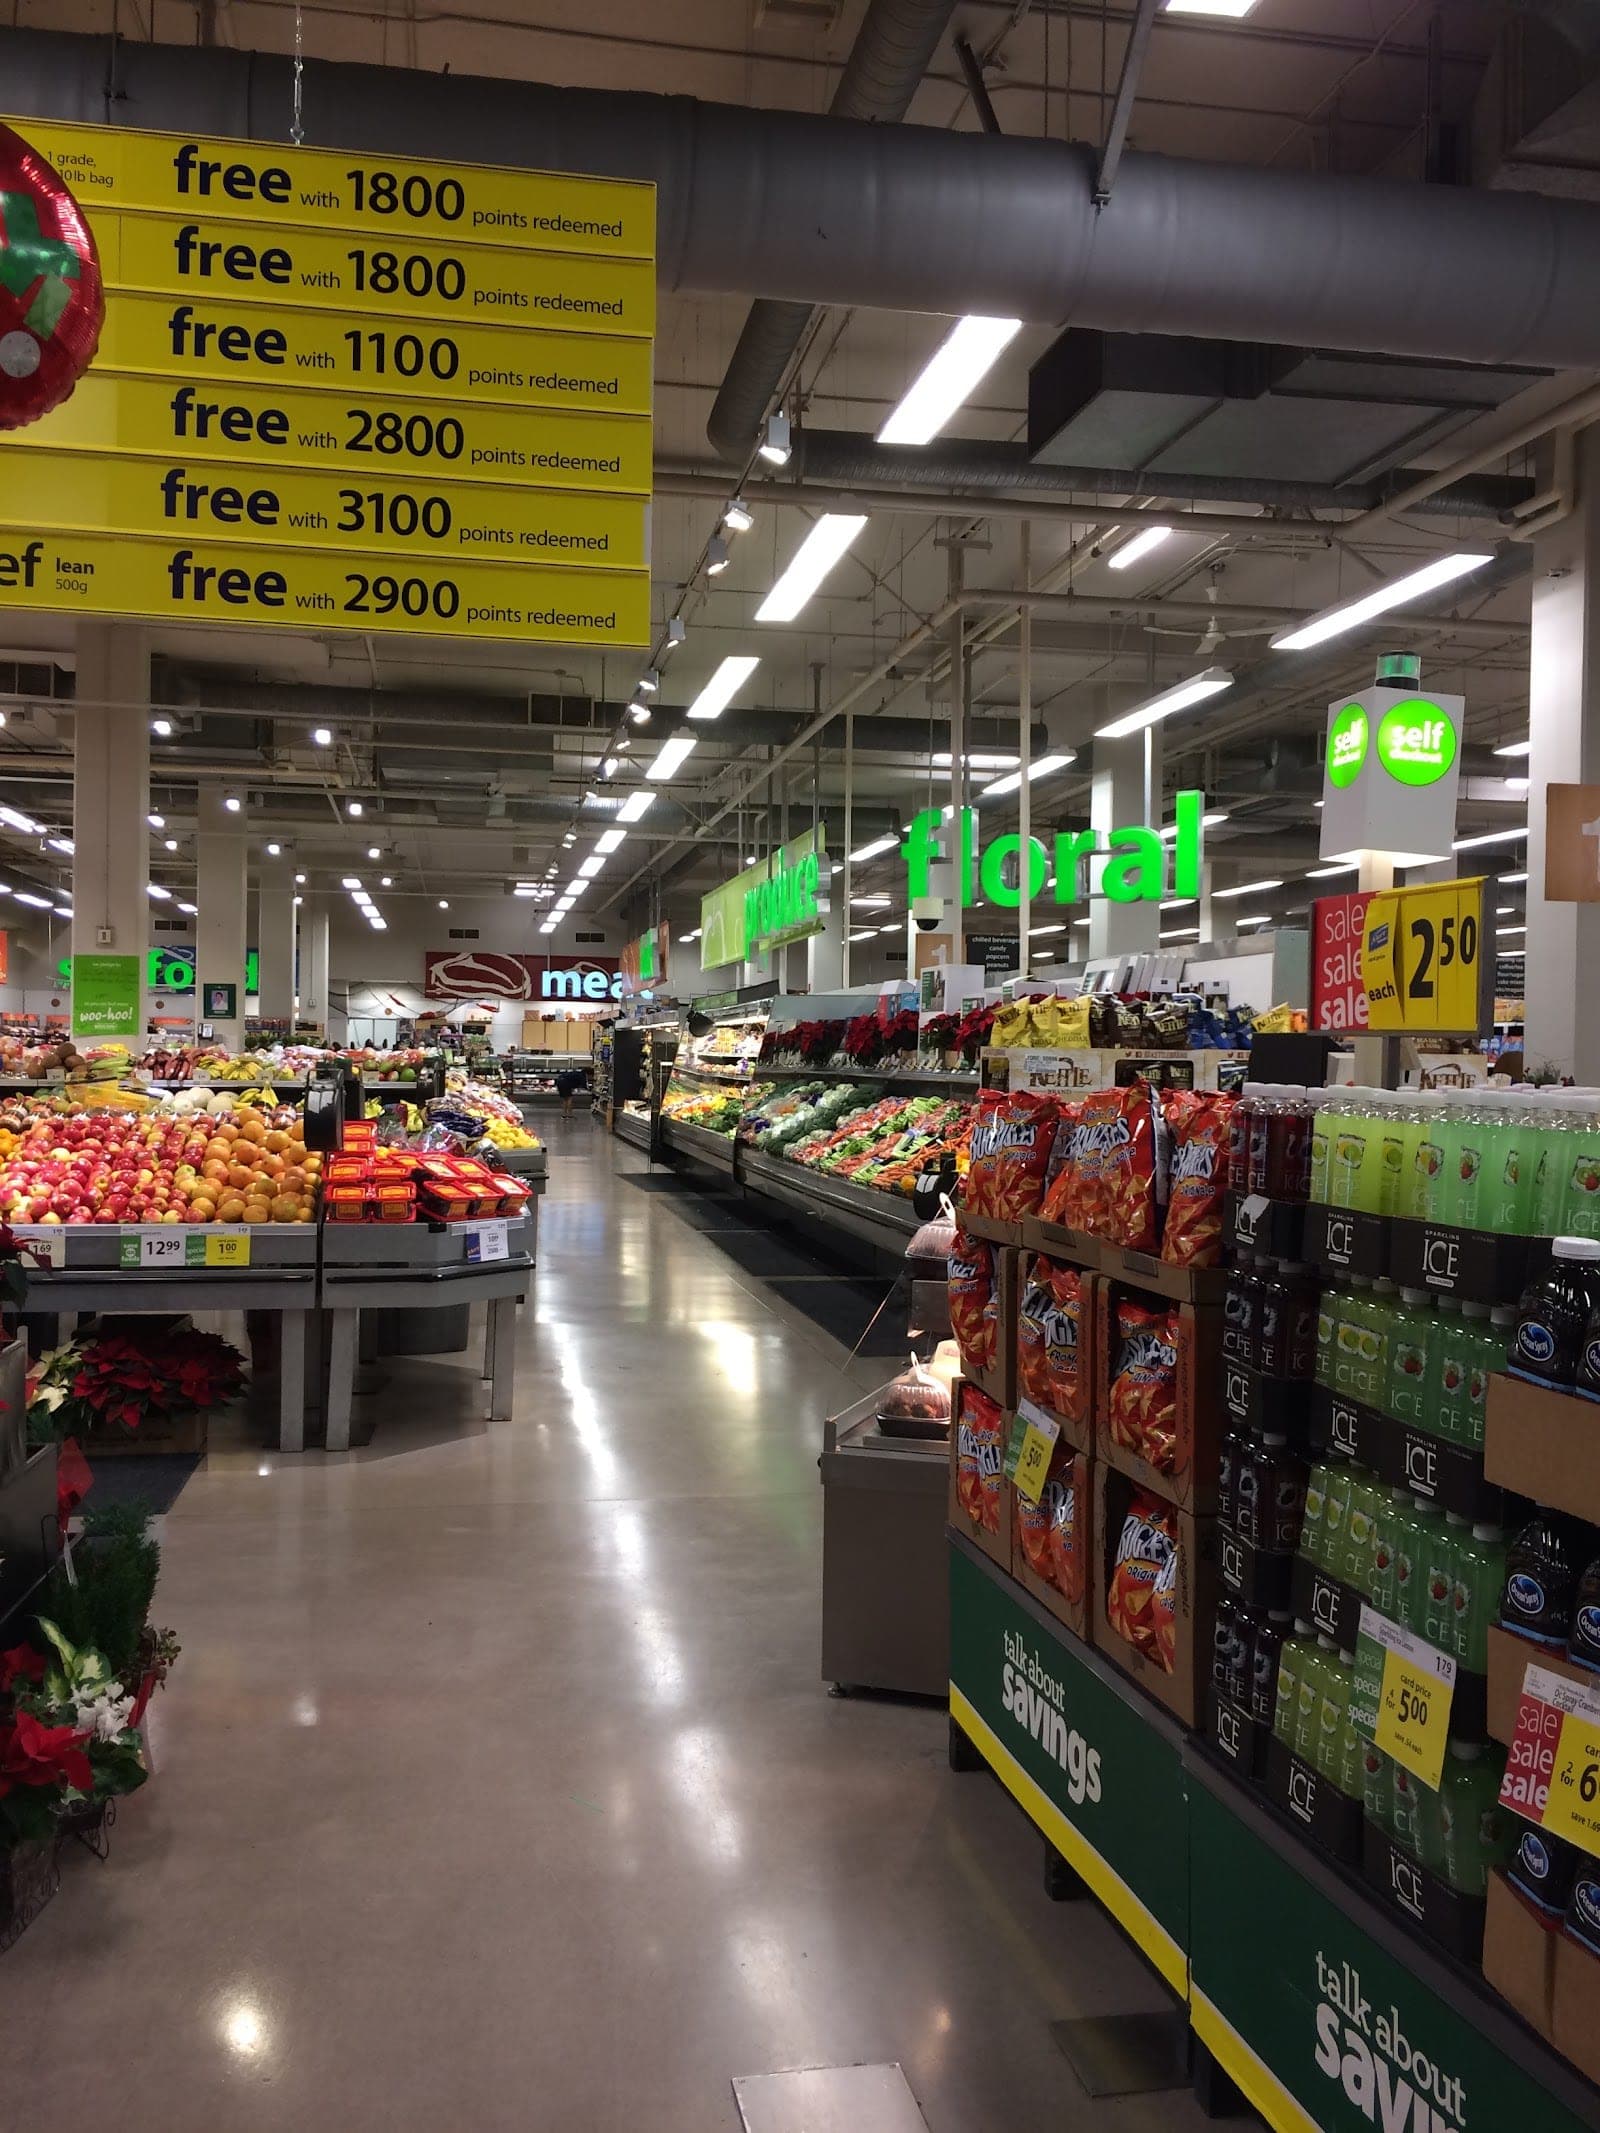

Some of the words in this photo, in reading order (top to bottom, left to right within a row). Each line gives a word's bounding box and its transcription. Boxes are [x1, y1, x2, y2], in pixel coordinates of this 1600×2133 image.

[57, 153, 97, 168] grade,
[90, 172, 115, 188] bag
[174, 145, 293, 203] free
[301, 192, 339, 209] with
[347, 168, 465, 221] 1800
[473, 209, 528, 229] points
[534, 213, 623, 238] redeemed
[174, 225, 292, 284] free
[301, 271, 340, 289] with
[348, 249, 465, 301] 1800
[474, 288, 529, 309] points
[534, 292, 623, 317] redeemed
[169, 306, 287, 364] free
[296, 351, 335, 369] with
[344, 329, 459, 380] 1100
[469, 368, 524, 388] points
[530, 373, 618, 395] redeemed
[171, 387, 289, 444] free
[298, 431, 338, 449] with
[345, 410, 464, 459] 2800
[471, 447, 526, 467] points
[531, 452, 621, 473] redeemed
[160, 468, 280, 525] free
[289, 511, 328, 529] with
[337, 490, 451, 538] 3100
[460, 525, 514, 545] points
[519, 530, 609, 551] redeemed
[56, 558, 94, 575] lean
[56, 579, 88, 595] 500g
[168, 550, 287, 606] free
[296, 592, 335, 610] with
[343, 574, 459, 618] 2900
[466, 604, 521, 624] points
[527, 607, 617, 630] redeemed
[1333, 717, 1364, 754] self
[1391, 720, 1445, 751] self
[901, 790, 1204, 908] floral
[1324, 896, 1364, 945] sale
[989, 945, 1007, 953] candy
[1323, 943, 1361, 989] sale
[541, 969, 655, 1000] mea
[1369, 980, 1395, 1001] each
[80, 1006, 133, 1023] woo-hoo!
[1320, 987, 1368, 1030] sale
[1248, 1171, 1266, 1190] CE
[1326, 1221, 1354, 1255] ICE
[1424, 1229, 1460, 1241] SPARKLING
[1422, 1239, 1460, 1278] ICE
[1316, 1353, 1330, 1374] CE
[1226, 1371, 1249, 1408] ICE
[1358, 1370, 1378, 1392] CE
[1331, 1407, 1358, 1448] ICE
[1439, 1407, 1461, 1431] CE
[1404, 1442, 1438, 1487] ICE
[1300, 1527, 1320, 1550] CE
[1222, 1539, 1243, 1582] ICE
[1345, 1553, 1365, 1576] CE
[1312, 1582, 1340, 1627] ICE
[1425, 1616, 1451, 1643] CE
[1003, 1629, 1027, 1673] talk
[1028, 1651, 1066, 1712] about
[1353, 1675, 1380, 1698] special
[1400, 1673, 1415, 1690] card
[1415, 1683, 1432, 1700] price
[1252, 1691, 1269, 1715] CE
[1348, 1704, 1376, 1729] special
[1386, 1696, 1396, 1711] for
[1517, 1701, 1558, 1739] sale
[1002, 1663, 1102, 1805] savings
[1216, 1706, 1241, 1751] ICE
[1510, 1739, 1553, 1775] sale
[1566, 1761, 1574, 1773] 2
[1288, 1766, 1316, 1816] ICE
[1500, 1772, 1549, 1811] sale
[1560, 1771, 1574, 1788] for
[1363, 1790, 1384, 1815] CE
[1571, 1811, 1586, 1825] save
[1390, 1854, 1425, 1913] ICE
[1316, 1951, 1371, 2037] talk
[1375, 2005, 1467, 2127] about
